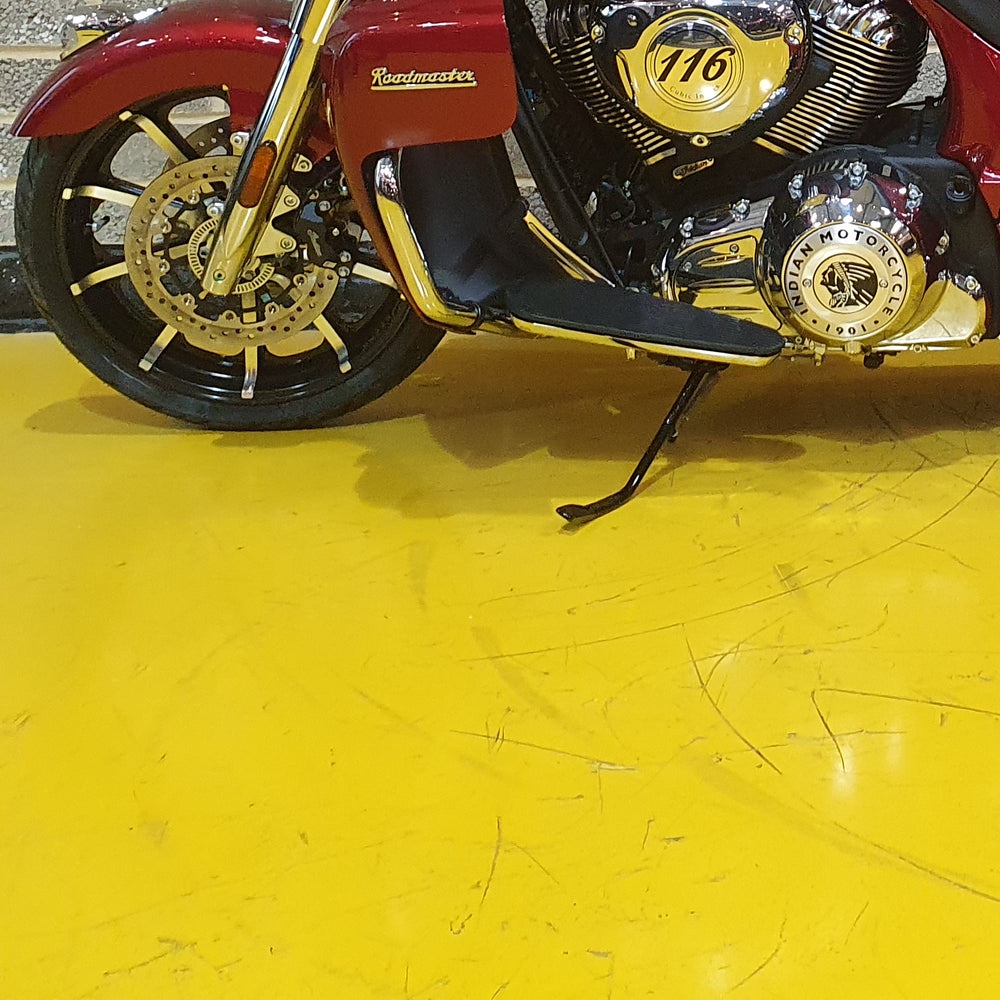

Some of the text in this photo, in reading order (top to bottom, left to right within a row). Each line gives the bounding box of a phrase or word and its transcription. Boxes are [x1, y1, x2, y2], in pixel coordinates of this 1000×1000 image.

[371, 67, 476, 86] Roadmaster
[657, 48, 737, 83] 116
[788, 229, 903, 317] INDIAN MOTORCYCLE
[826, 324, 867, 335] 1901
